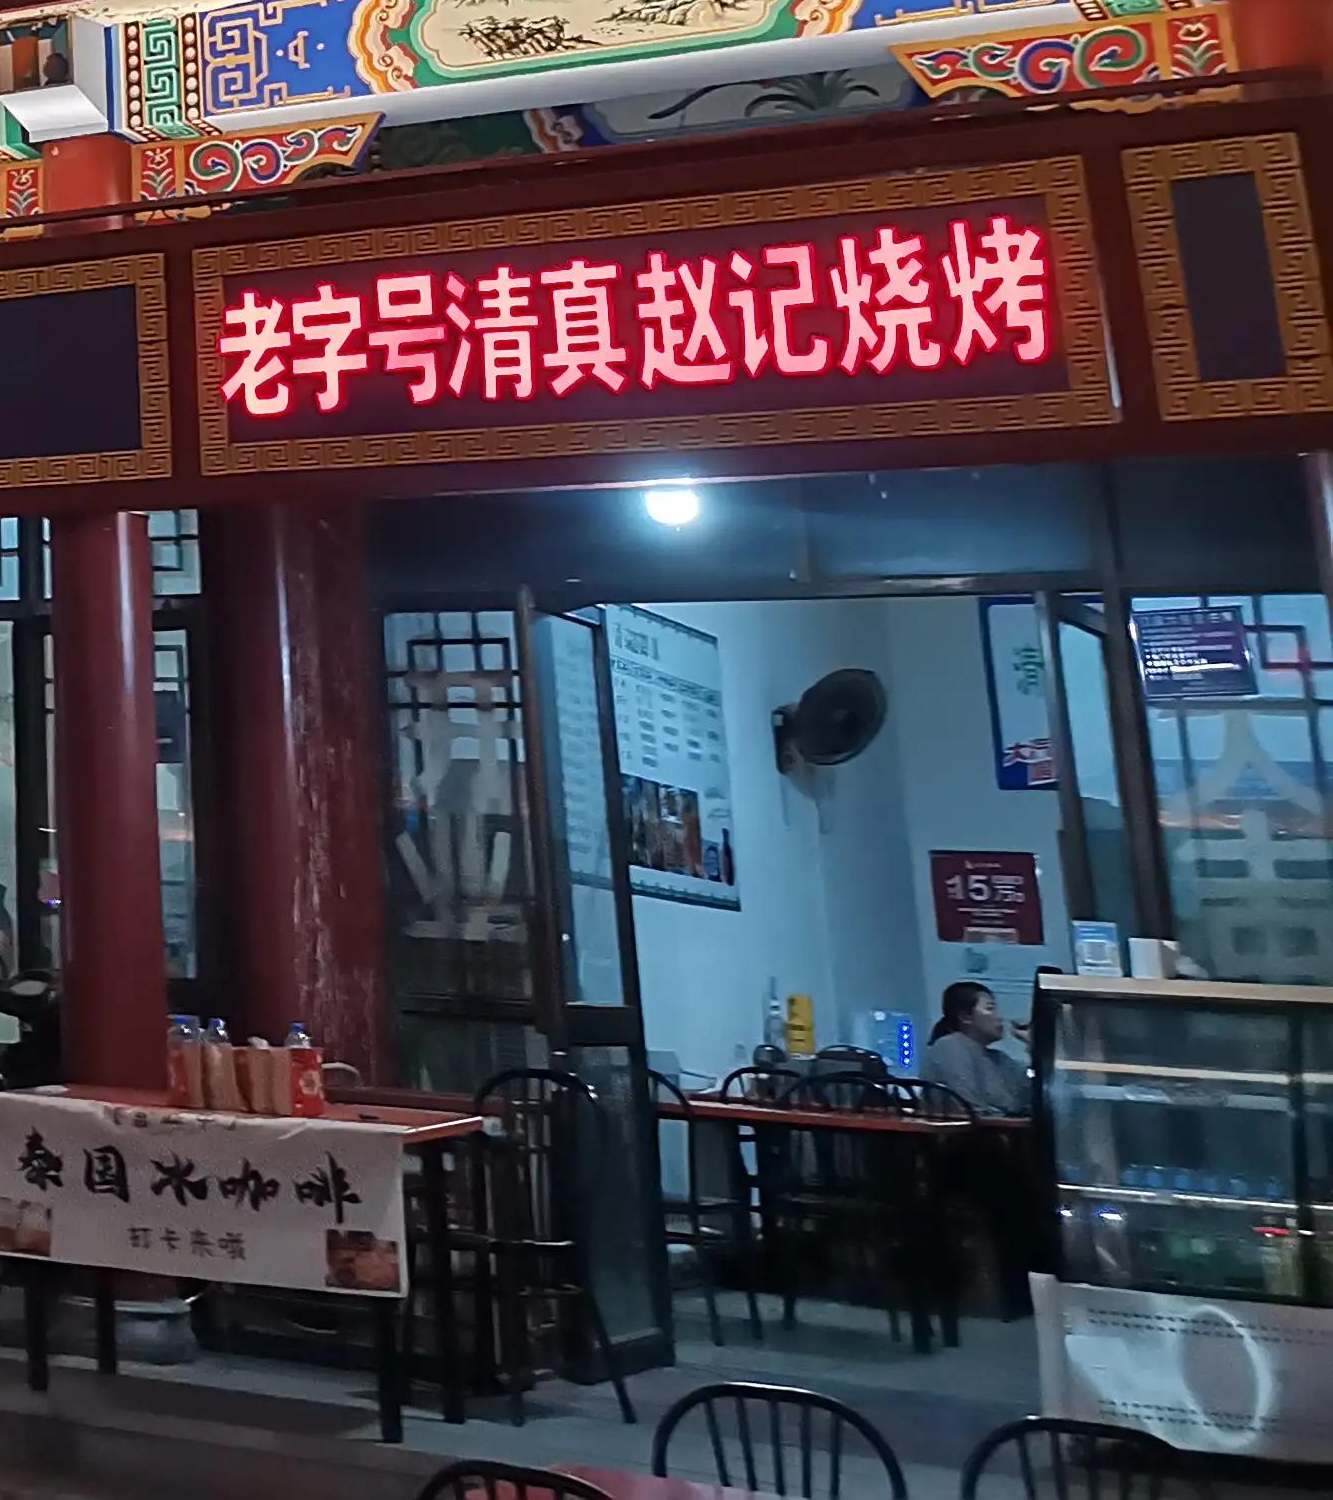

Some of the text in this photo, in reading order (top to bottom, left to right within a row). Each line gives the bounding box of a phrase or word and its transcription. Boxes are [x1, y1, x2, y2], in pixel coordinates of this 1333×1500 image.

[218, 215, 1047, 416] 老字号清真赵记烧烤
